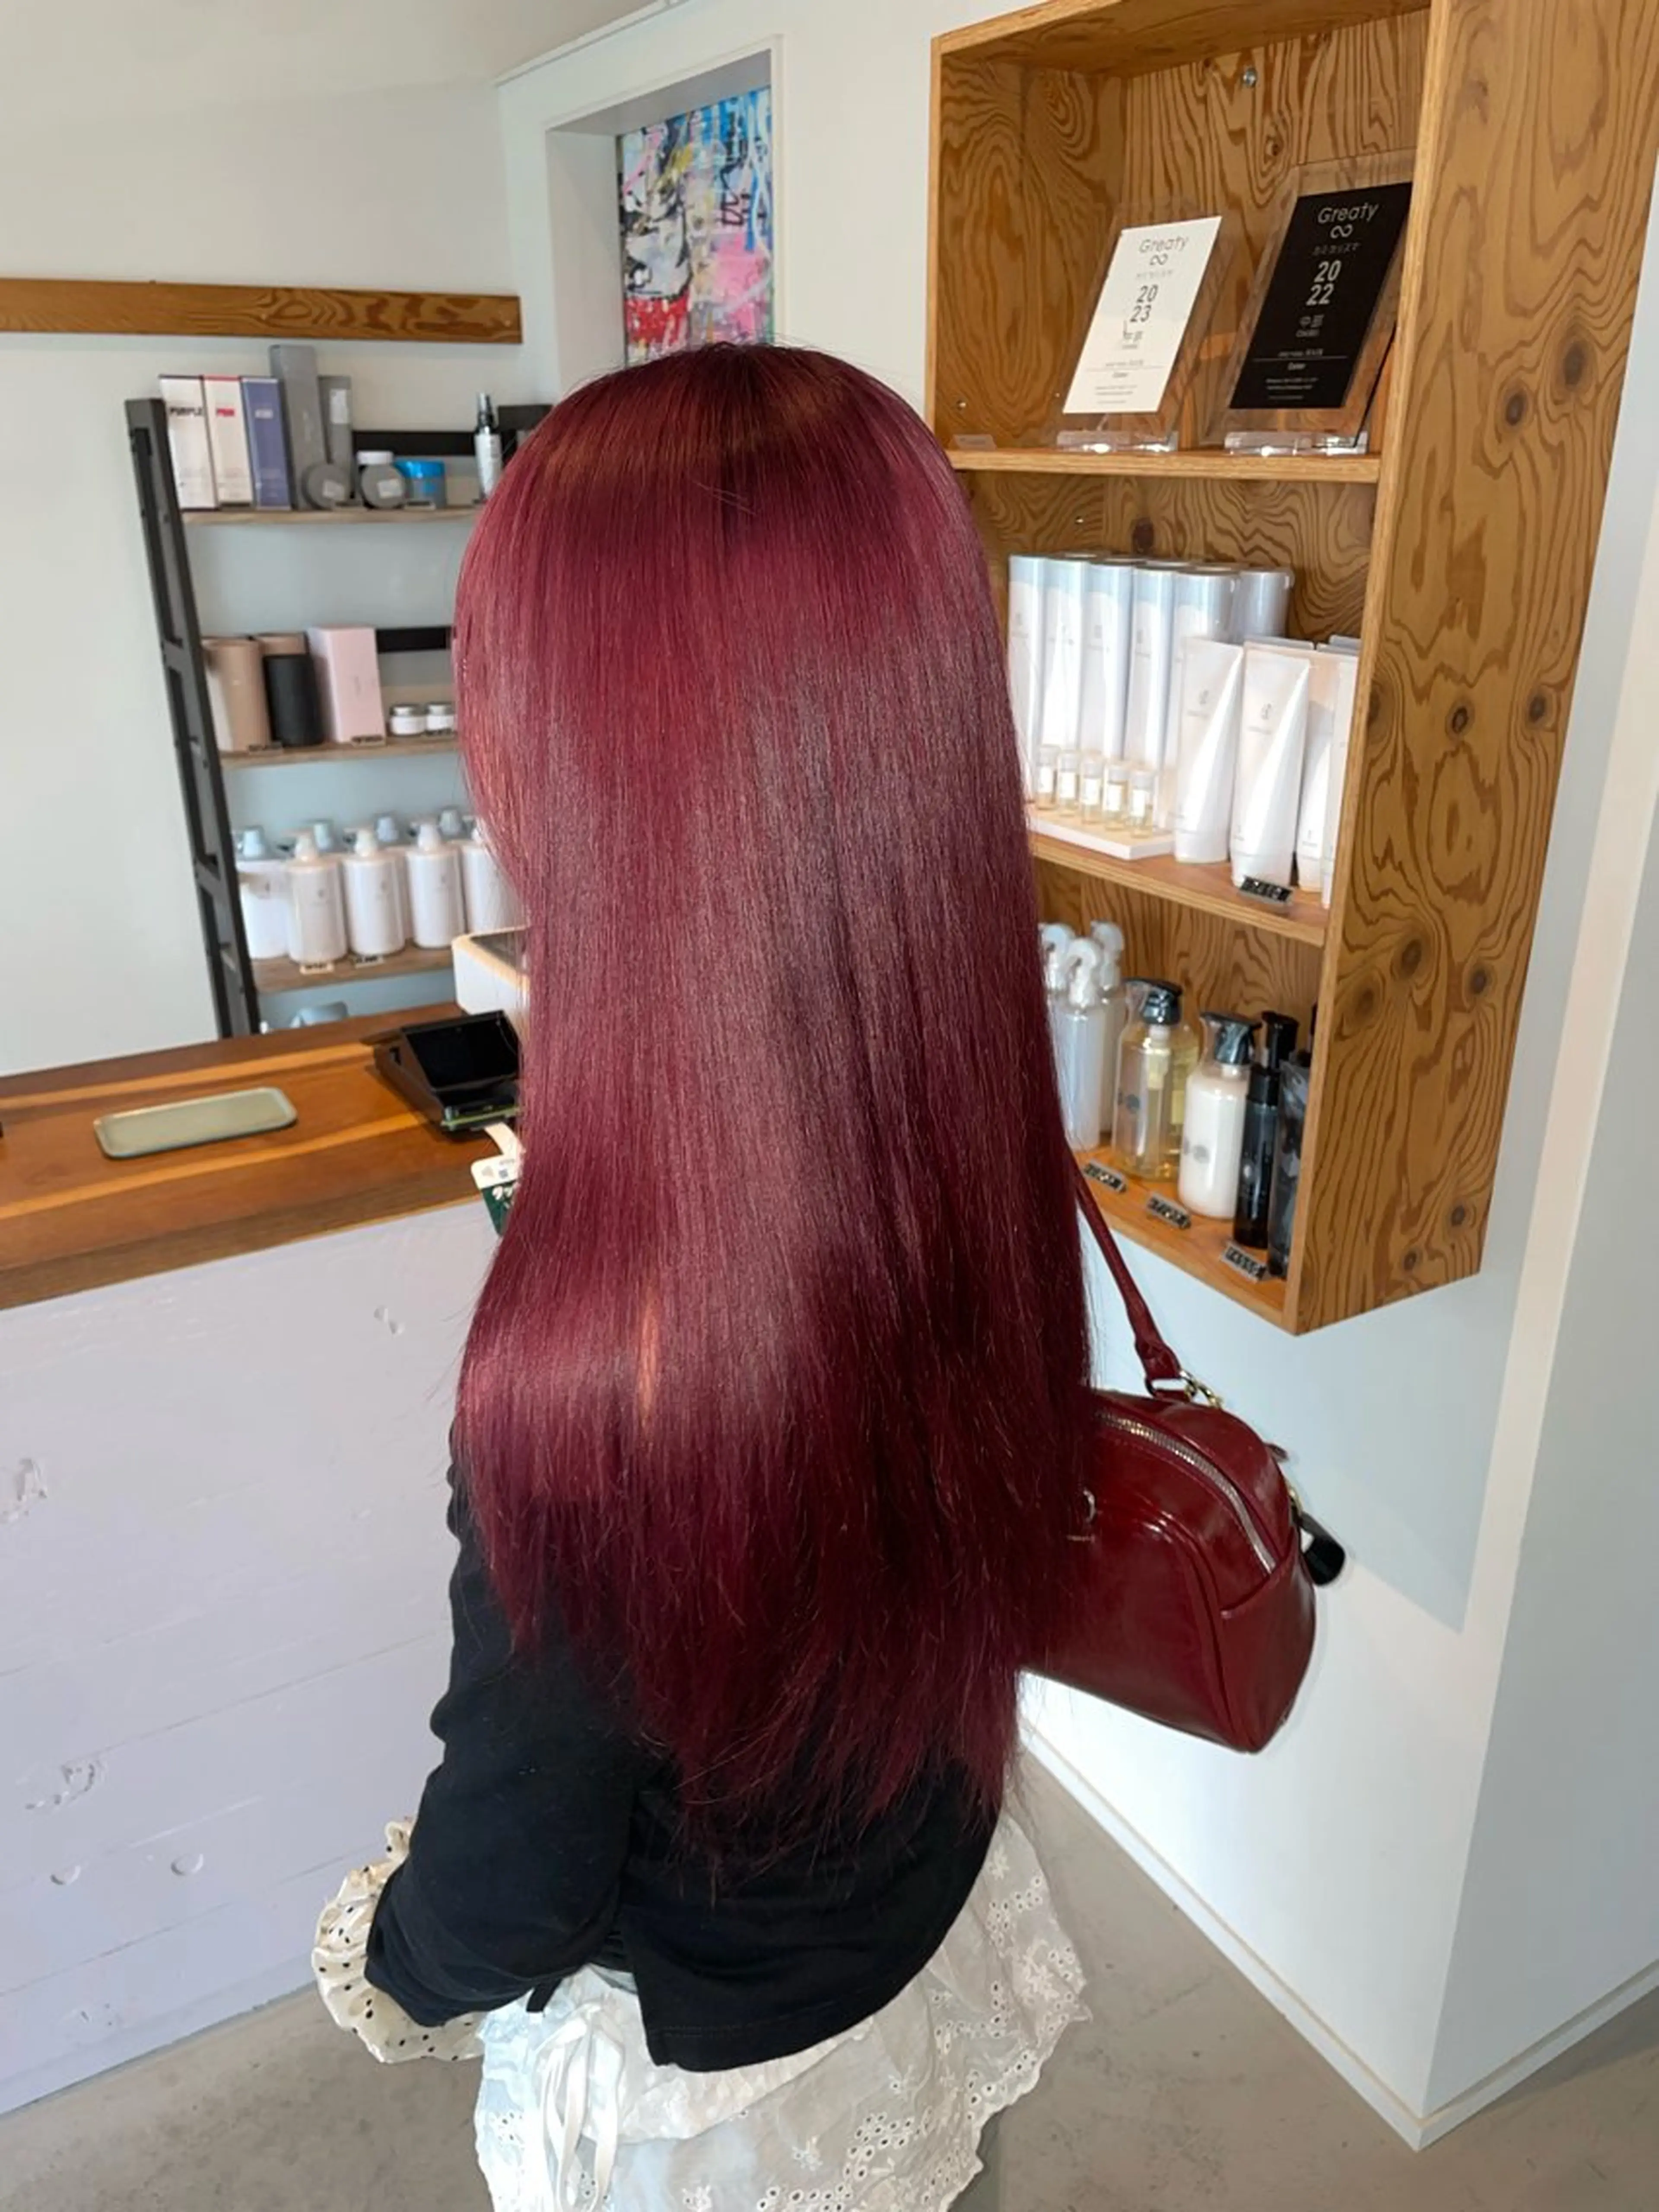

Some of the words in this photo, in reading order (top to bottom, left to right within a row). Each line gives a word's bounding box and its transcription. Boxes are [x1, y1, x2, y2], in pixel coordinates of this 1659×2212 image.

[1318, 202, 1379, 224] Greaty
[1139, 236, 1189, 253] Greaty
[1314, 260, 1342, 283] 20
[1137, 284, 1158, 302] 20
[1306, 283, 1334, 306] 22
[1130, 305, 1151, 322] 23
